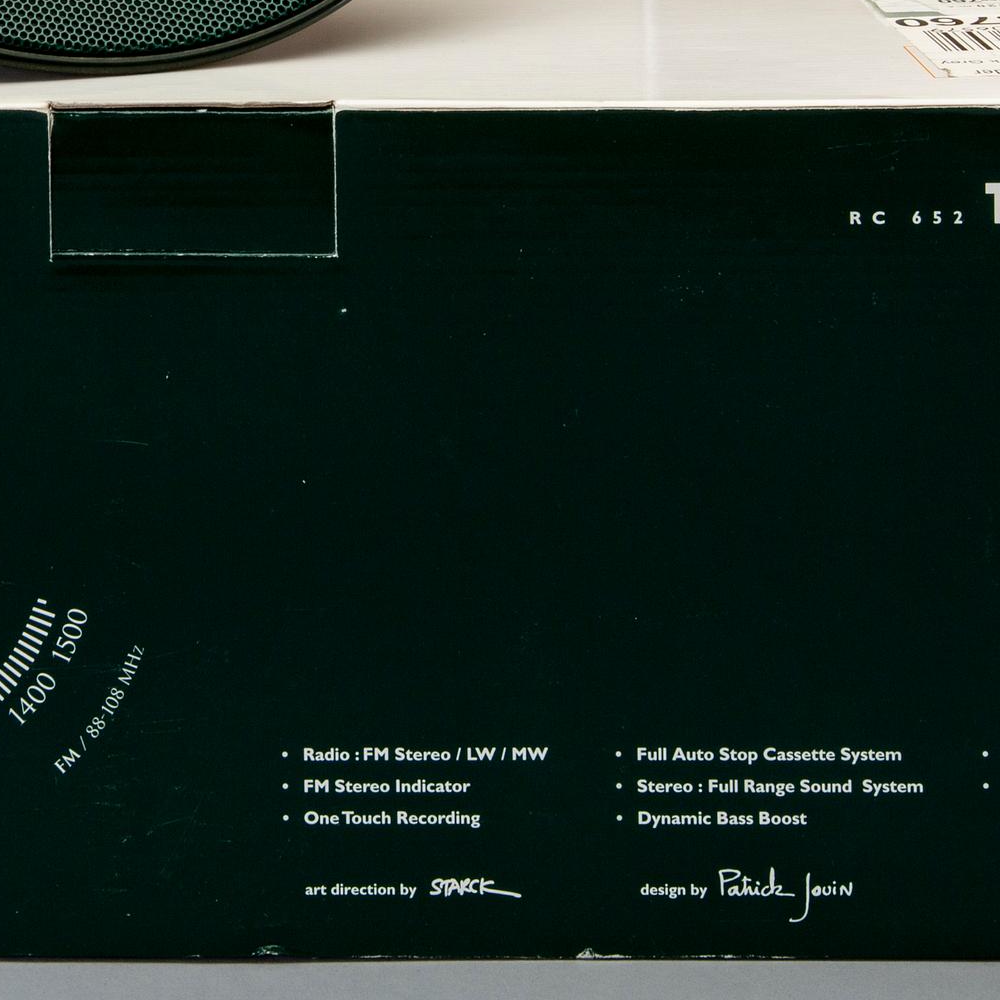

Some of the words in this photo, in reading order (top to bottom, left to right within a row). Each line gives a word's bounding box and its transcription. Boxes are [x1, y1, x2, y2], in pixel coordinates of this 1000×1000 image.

[895, 16, 1000, 27] 760
[849, 211, 886, 225] RC
[912, 211, 963, 225] 652
[50, 607, 88, 662] 1500
[8, 671, 56, 725] 1400
[54, 749, 82, 774] FM
[86, 687, 125, 739] 88-108
[121, 643, 146, 688] MHz
[303, 747, 350, 761] Radio
[394, 747, 451, 761] Stereo
[467, 747, 496, 761] LW
[512, 746, 549, 761] MW
[637, 747, 667, 761] Full
[672, 747, 715, 761] Auto
[719, 747, 758, 765] Stop
[763, 747, 836, 761] Cassette
[840, 747, 902, 765] System
[303, 779, 330, 793] FM
[334, 779, 390, 793] Stereo
[395, 779, 471, 793] Indicator
[637, 779, 694, 793] Stereo
[708, 779, 739, 793] Full
[744, 779, 795, 797] Range
[799, 779, 852, 793] Sound
[862, 779, 924, 797] System
[303, 811, 340, 825] One
[341, 810, 392, 825] Touch
[396, 810, 481, 829] Recording
[638, 811, 712, 829] Dynamic
[716, 811, 754, 825] Bass
[758, 811, 808, 825] Boost
[305, 885, 327, 896] art
[330, 883, 396, 896] direction
[400, 883, 417, 899] by
[429, 877, 522, 899] STARCK
[640, 883, 686, 899] design
[690, 883, 708, 899] by
